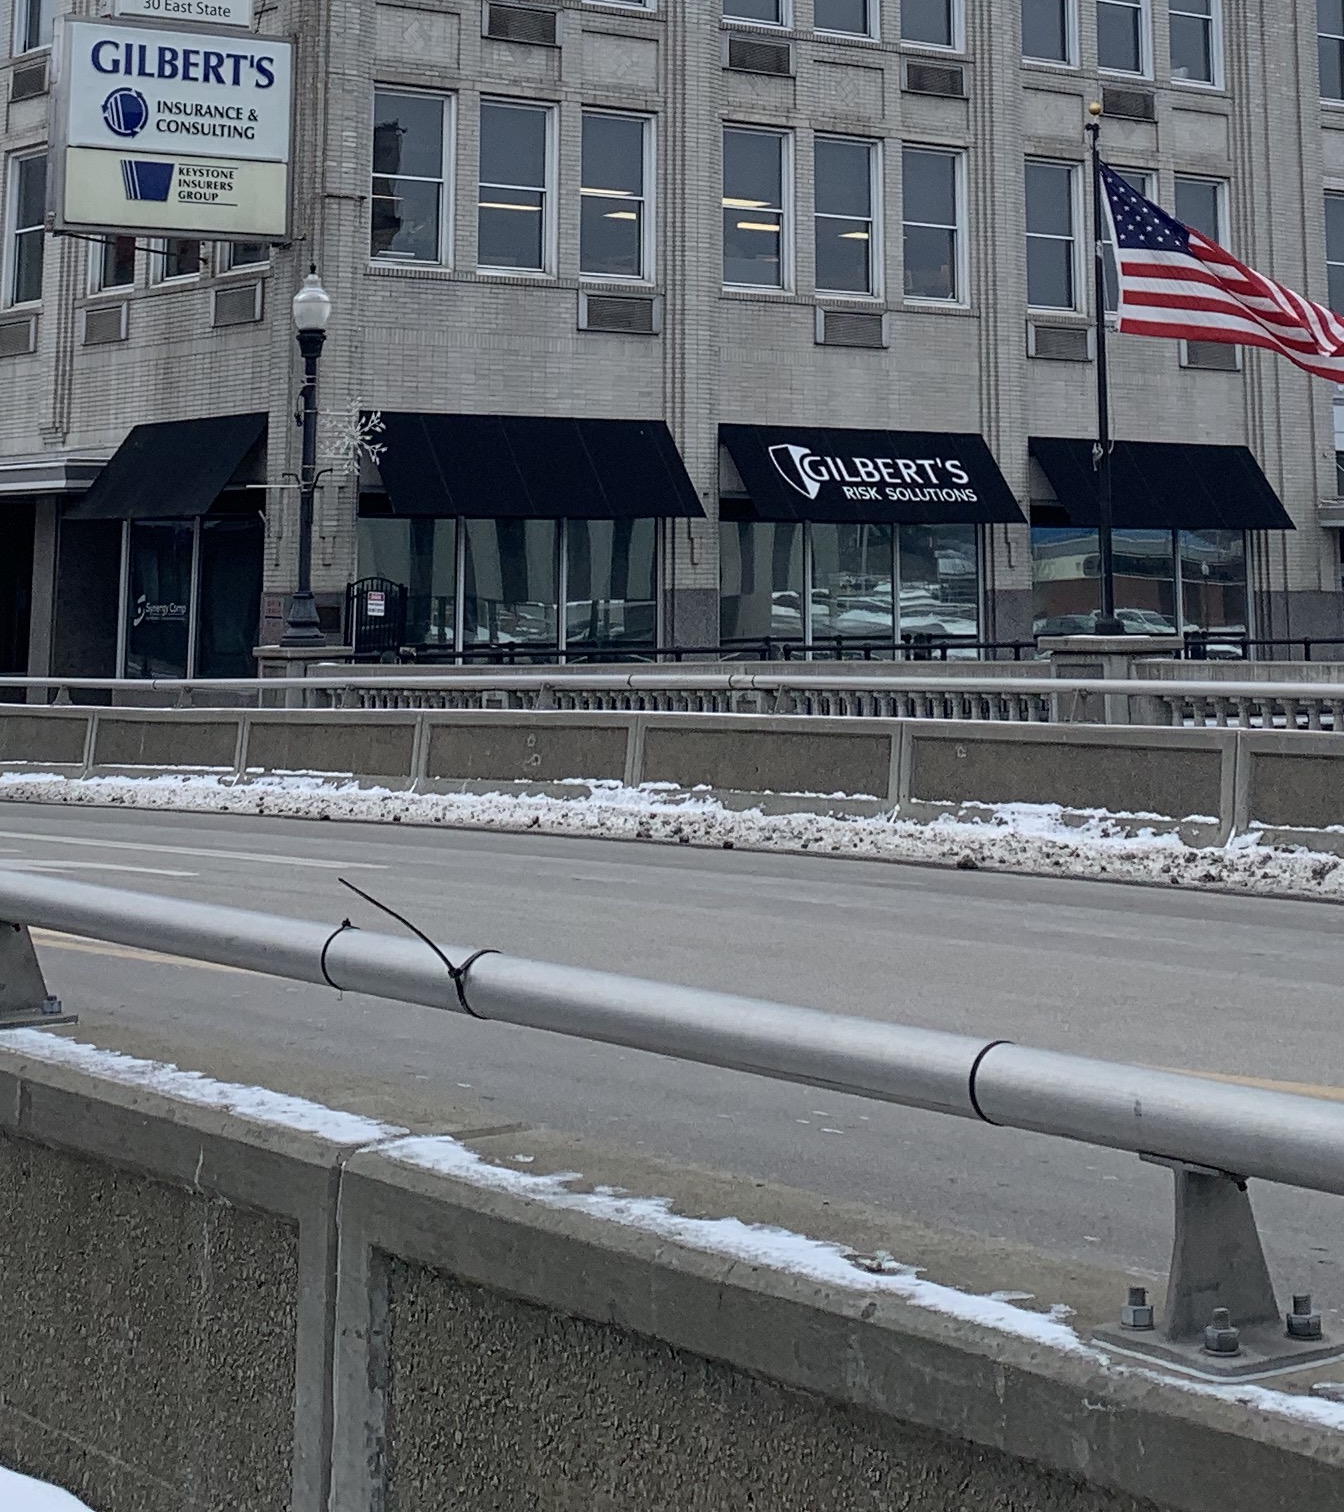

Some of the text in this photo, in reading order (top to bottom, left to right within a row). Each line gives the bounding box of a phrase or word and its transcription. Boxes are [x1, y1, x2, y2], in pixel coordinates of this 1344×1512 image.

[196, 1, 231, 18] State
[91, 39, 275, 89] GILBERT'S
[157, 100, 258, 121] INSURANCE &
[156, 119, 256, 140] CONSULTING
[178, 166, 234, 180] KEYSTONE
[178, 179, 233, 191] INSURERS
[178, 191, 219, 202] GROUP
[803, 456, 970, 485] GILBERT'S
[842, 486, 978, 502] RISK SOLUTIONS
